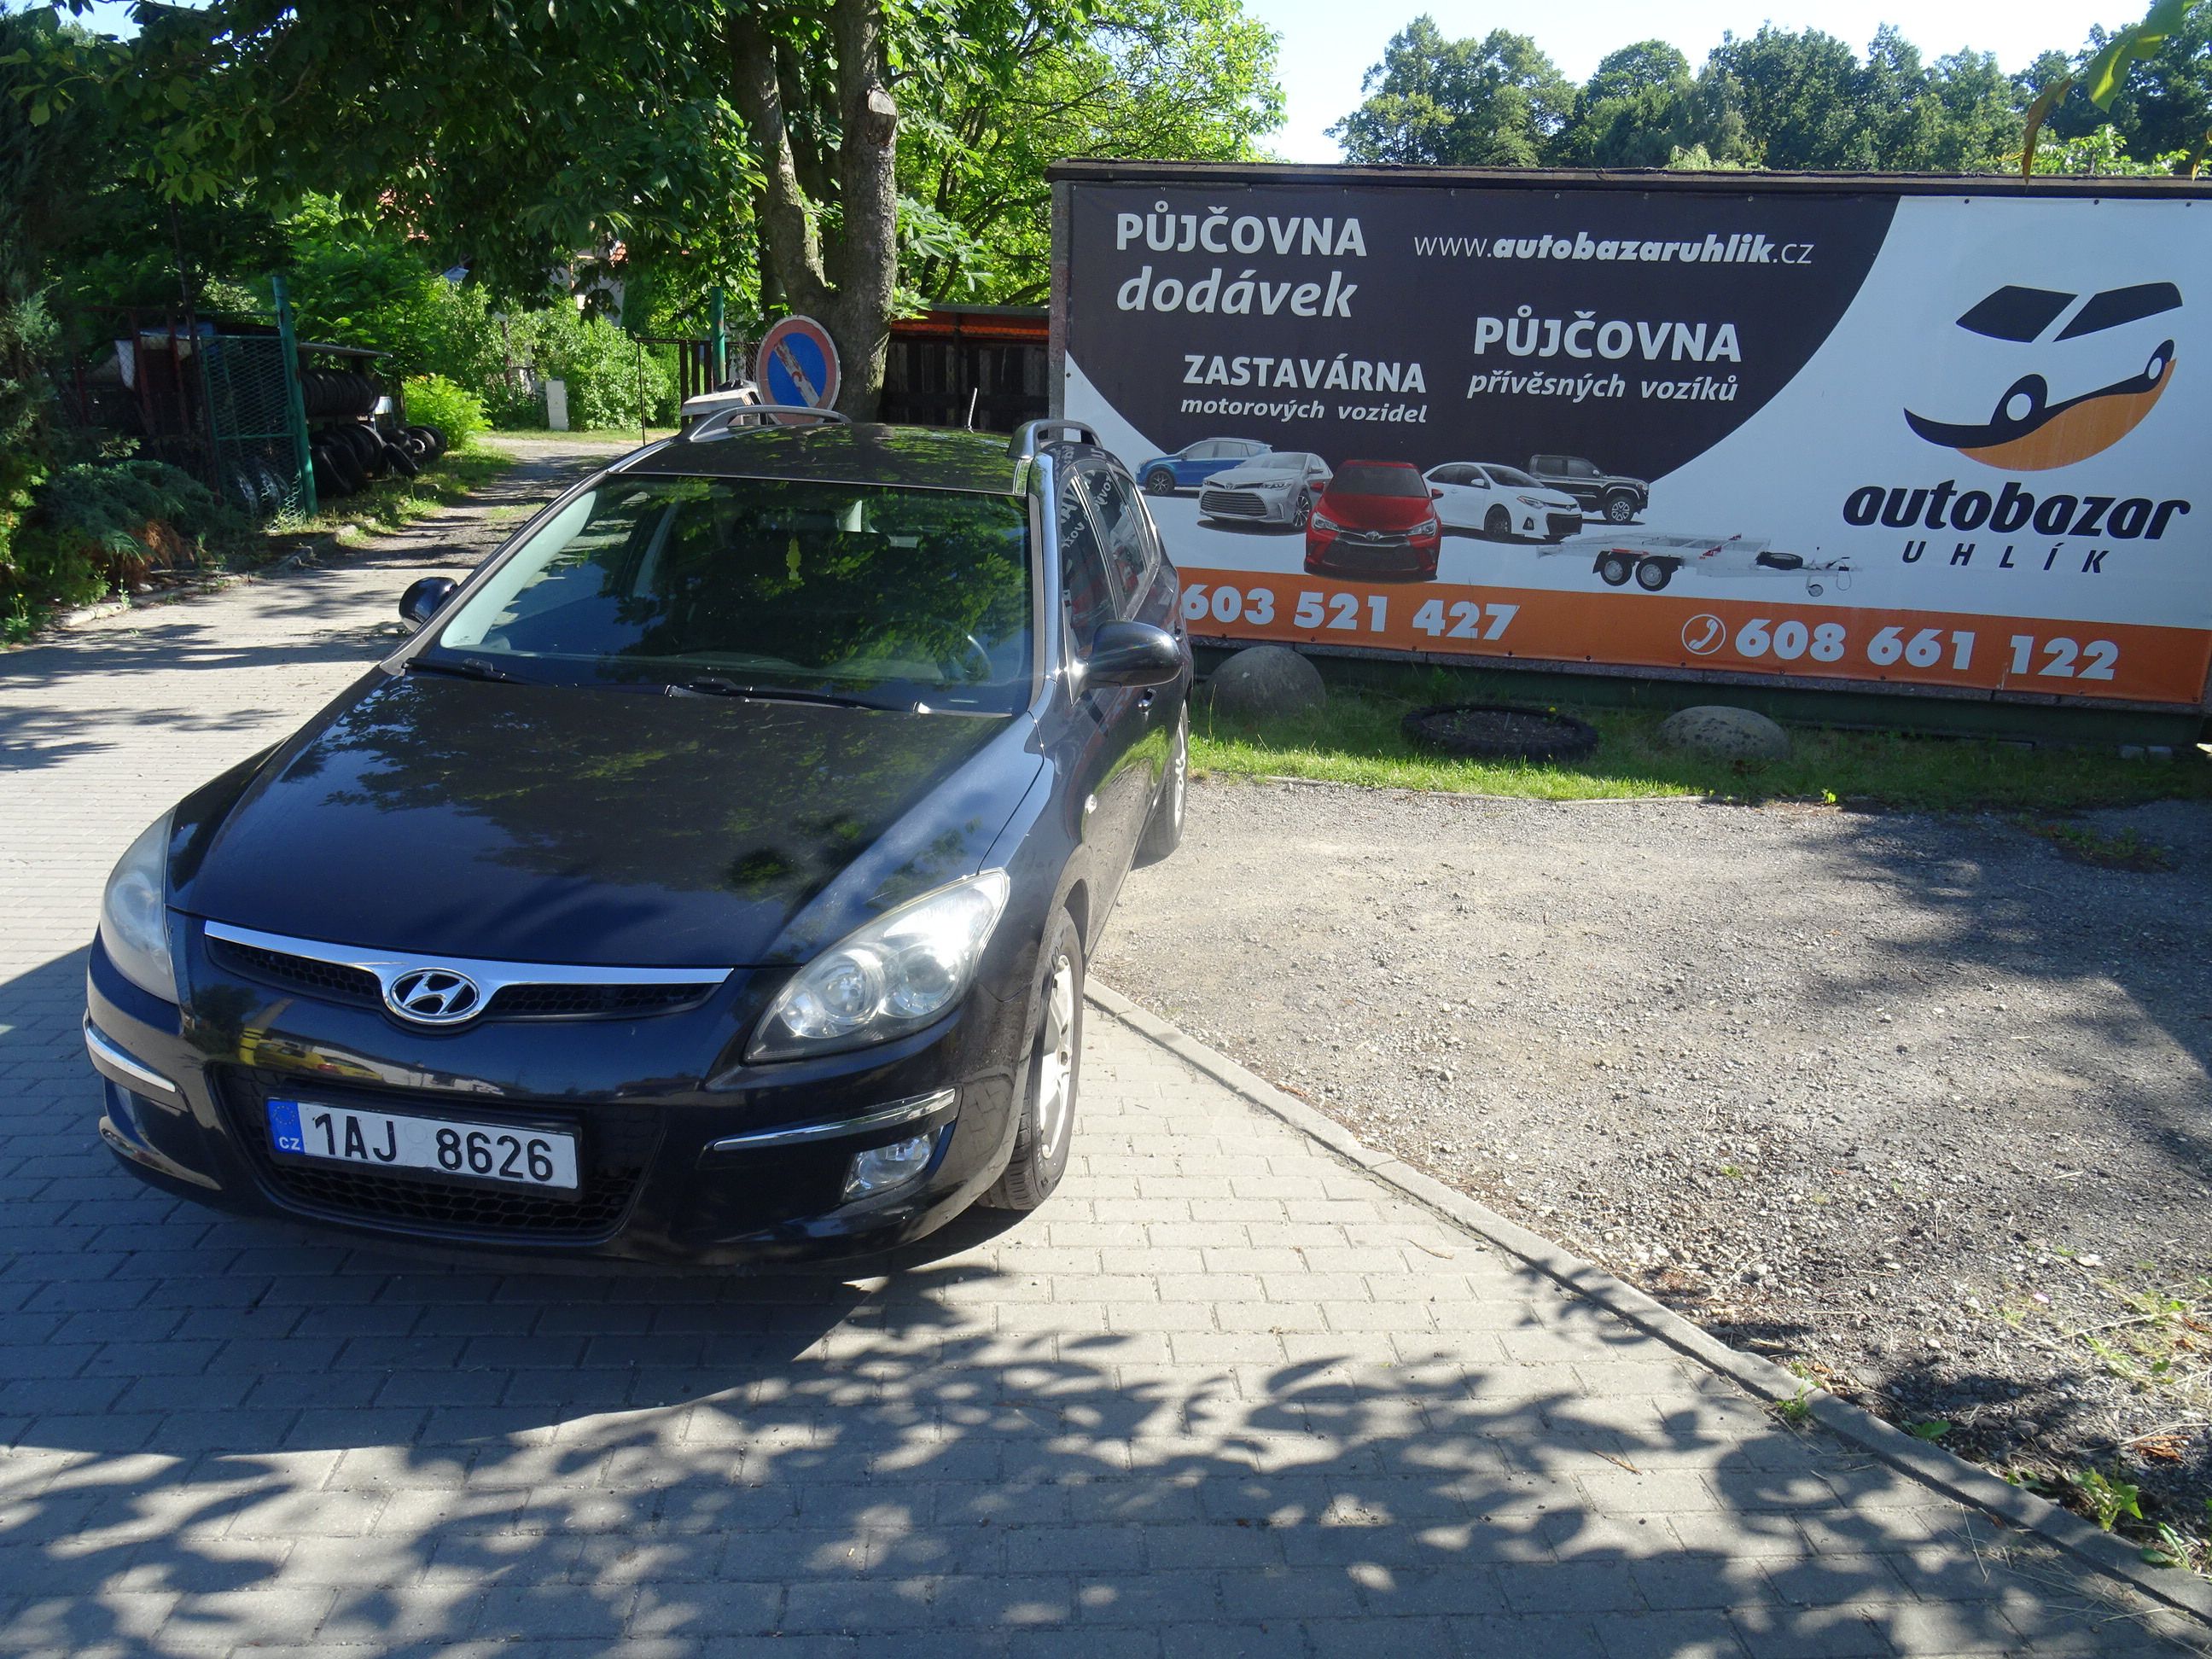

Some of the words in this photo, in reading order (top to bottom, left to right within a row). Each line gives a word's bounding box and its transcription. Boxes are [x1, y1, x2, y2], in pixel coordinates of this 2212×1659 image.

[1117, 201, 1366, 256] PŮJČOVNA
[1415, 232, 1814, 264] www.autobazaruhlik.cz
[1117, 266, 1358, 317] dodávek
[1475, 306, 1741, 362] PŮJČOVNA
[1184, 353, 1426, 393] ZASTAVÁRNA
[1467, 370, 1625, 403] přívěsných
[1642, 375, 1738, 400] vozíků
[1181, 399, 1324, 422] motorových
[1338, 404, 1427, 423] vozidel
[1843, 480, 2191, 540] autobazar
[1902, 540, 2109, 573] UHLÍK
[1182, 585, 1275, 625] 603
[1294, 591, 1387, 632] 521
[1413, 600, 1520, 640] 427
[1736, 619, 1845, 661] 608
[1867, 627, 1975, 669] 661
[2011, 636, 2118, 680] 122
[279, 1137, 300, 1150] CZ
[313, 1113, 398, 1162] 1AJ
[435, 1128, 554, 1182] 8626
